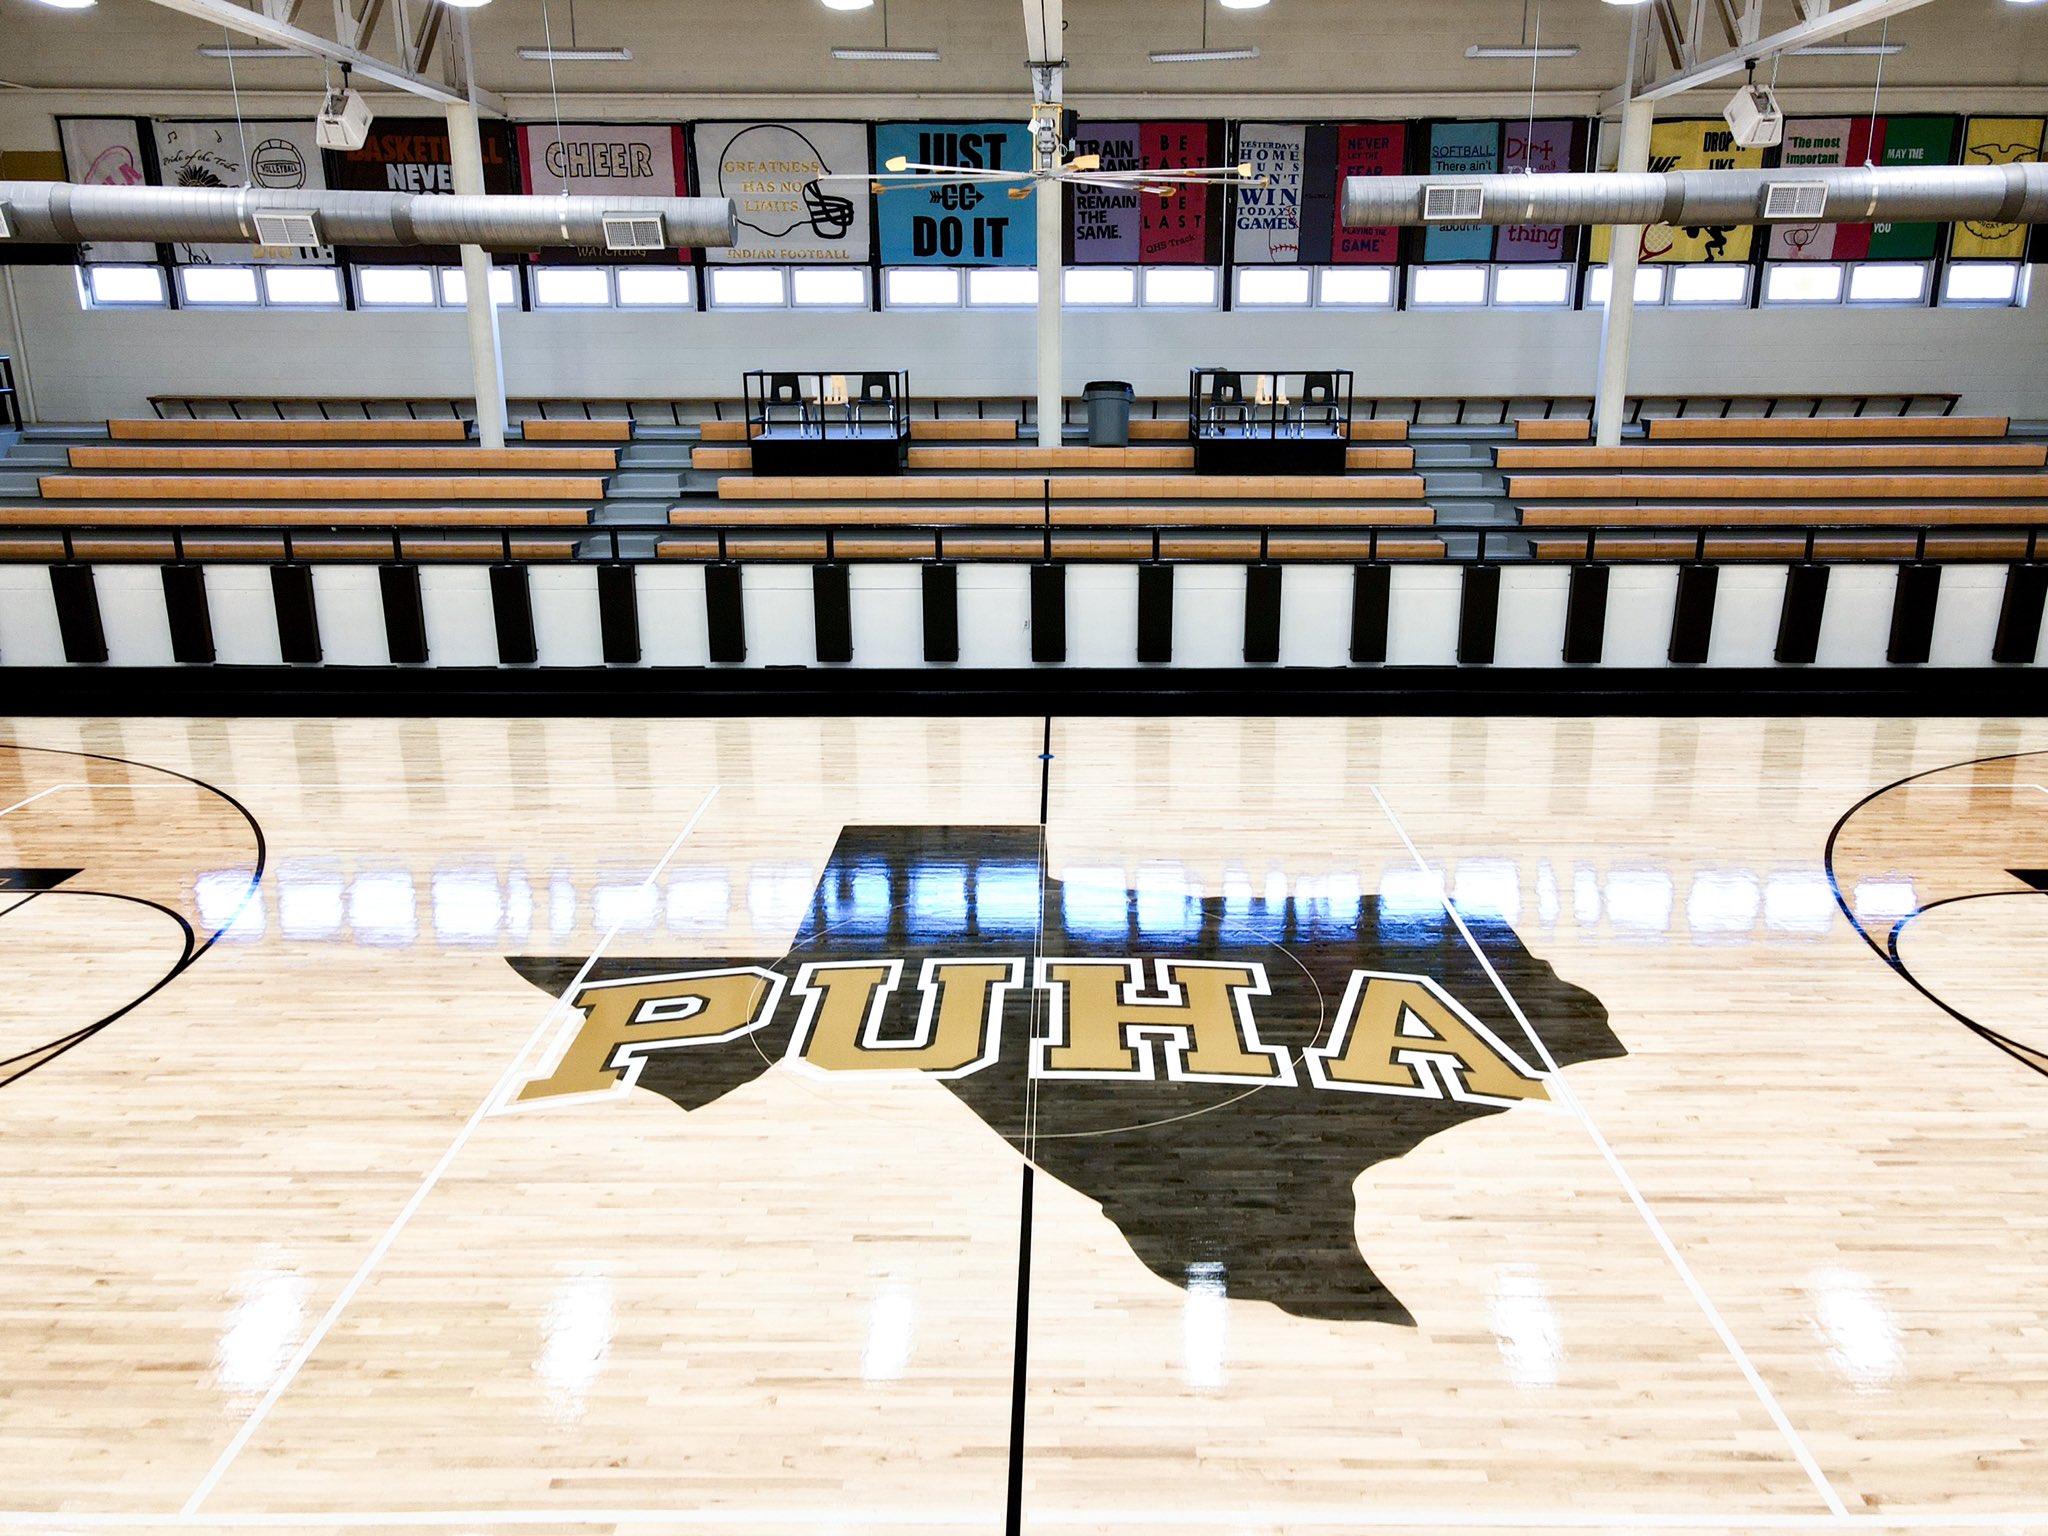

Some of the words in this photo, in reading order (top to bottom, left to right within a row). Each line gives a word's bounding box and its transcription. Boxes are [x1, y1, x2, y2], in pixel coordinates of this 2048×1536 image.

[1348, 138, 1389, 149] NEVER
[1703, 131, 1734, 152] DROP
[1813, 136, 1840, 148] most
[916, 133, 1007, 174] JUST
[1076, 140, 1133, 158] TRAIN
[1240, 149, 1300, 161] HOME
[1507, 138, 1553, 160] Dirt
[1887, 149, 1905, 159] MAY
[1908, 148, 1924, 160] THE
[545, 141, 654, 178] CHEER
[1436, 161, 1466, 171] There
[1469, 160, 1491, 171] ain't
[1786, 153, 1839, 165] important
[724, 161, 819, 173] GREATNESS
[1240, 162, 1300, 172] UNS
[385, 163, 454, 190] NEVE
[743, 181, 776, 193] HAS
[781, 181, 803, 193] NO
[1077, 196, 1136, 209] REMAIN
[1240, 188, 1298, 206] WIN
[1078, 211, 1107, 224] THE
[1144, 215, 1201, 229] LAST
[1237, 217, 1297, 230] GAMES
[1077, 226, 1122, 240] SAME.
[1873, 223, 1892, 233] YOU
[913, 216, 963, 258] DO
[973, 217, 1009, 258] IT
[1146, 241, 1168, 253] QHS
[1169, 233, 1196, 247] Track
[1508, 225, 1562, 249] thing
[728, 249, 776, 259] INDIAN
[780, 249, 850, 259] FOOTBALL
[484, 956, 1572, 1117] PUHA
